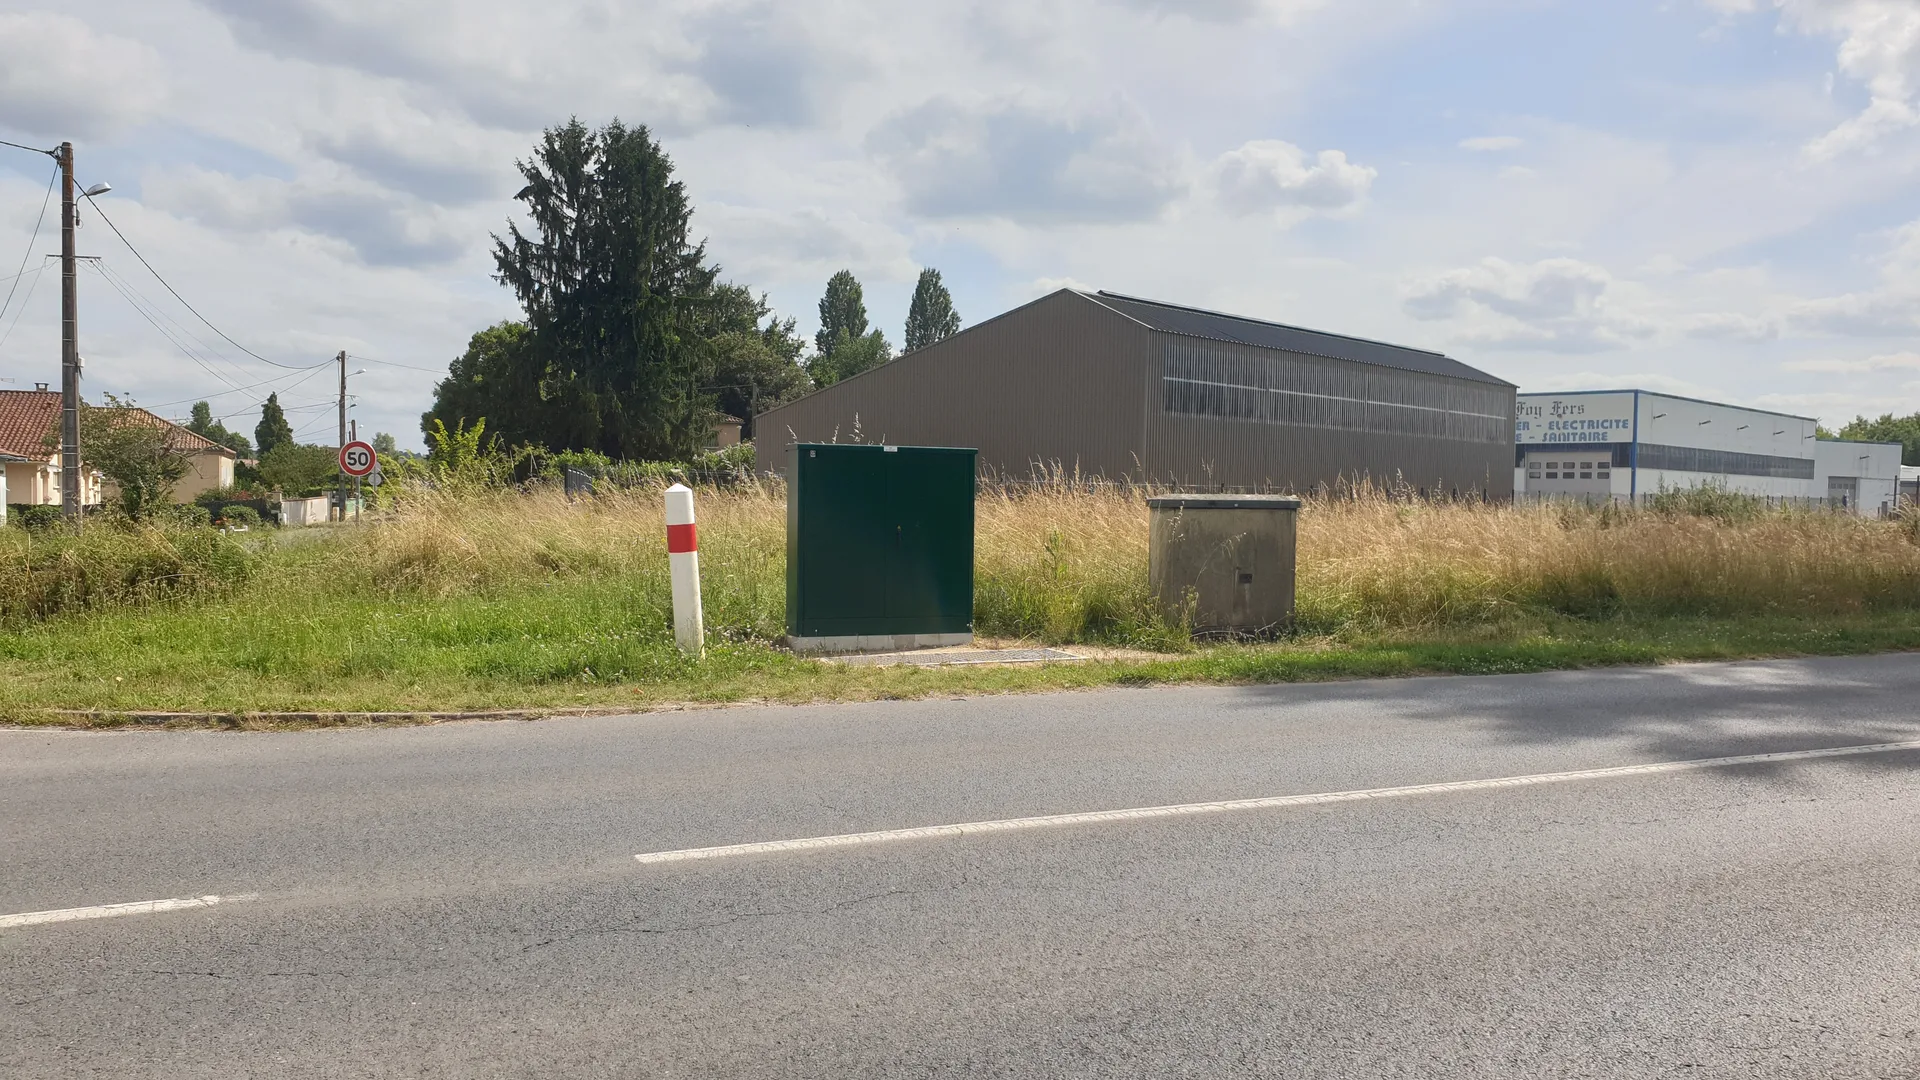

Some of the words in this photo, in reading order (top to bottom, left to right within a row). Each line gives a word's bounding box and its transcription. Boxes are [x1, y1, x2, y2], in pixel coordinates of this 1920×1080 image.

[1548, 419, 1629, 431] ELECTRICITE
[1542, 431, 1608, 442] SANITAIRE
[347, 452, 369, 466] 50
